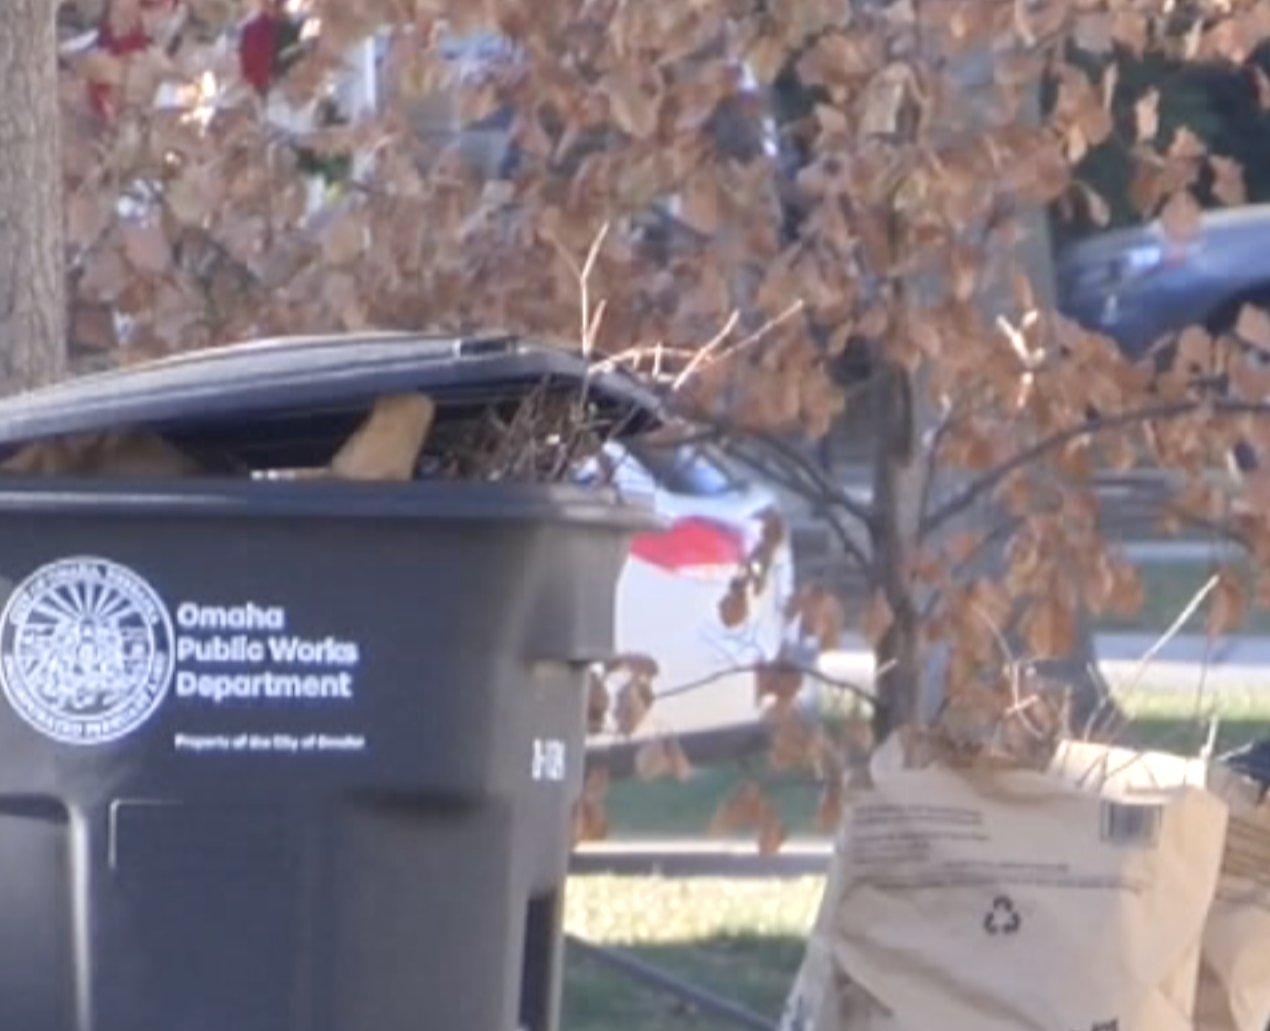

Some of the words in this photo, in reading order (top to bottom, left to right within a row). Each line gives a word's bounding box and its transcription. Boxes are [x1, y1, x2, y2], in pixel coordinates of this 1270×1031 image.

[177, 601, 285, 630] Omaha
[177, 634, 264, 663] Public
[268, 636, 359, 666] Works
[177, 670, 352, 703] Department
